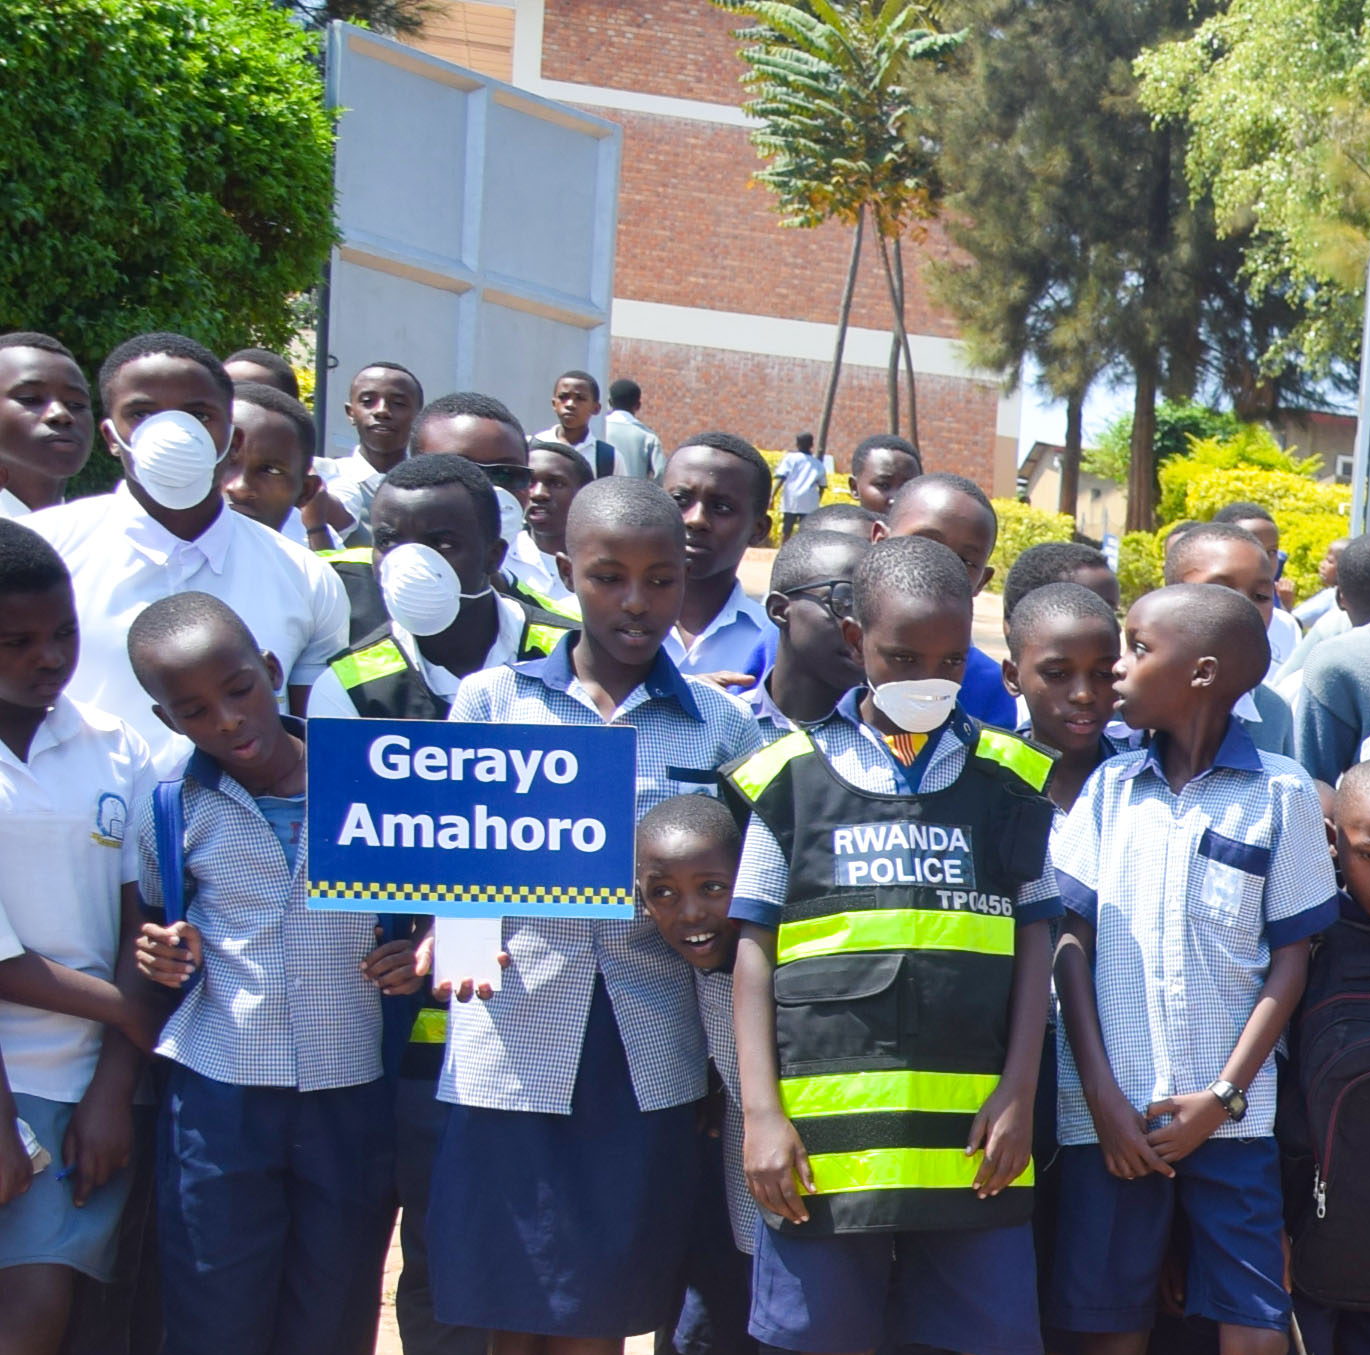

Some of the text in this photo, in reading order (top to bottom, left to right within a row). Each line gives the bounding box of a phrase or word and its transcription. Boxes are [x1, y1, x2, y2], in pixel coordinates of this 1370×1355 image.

[369, 735, 579, 794] Gerayo
[338, 802, 607, 853] Amahoro
[833, 824, 970, 855] RWANDA
[849, 857, 964, 885] POLICE
